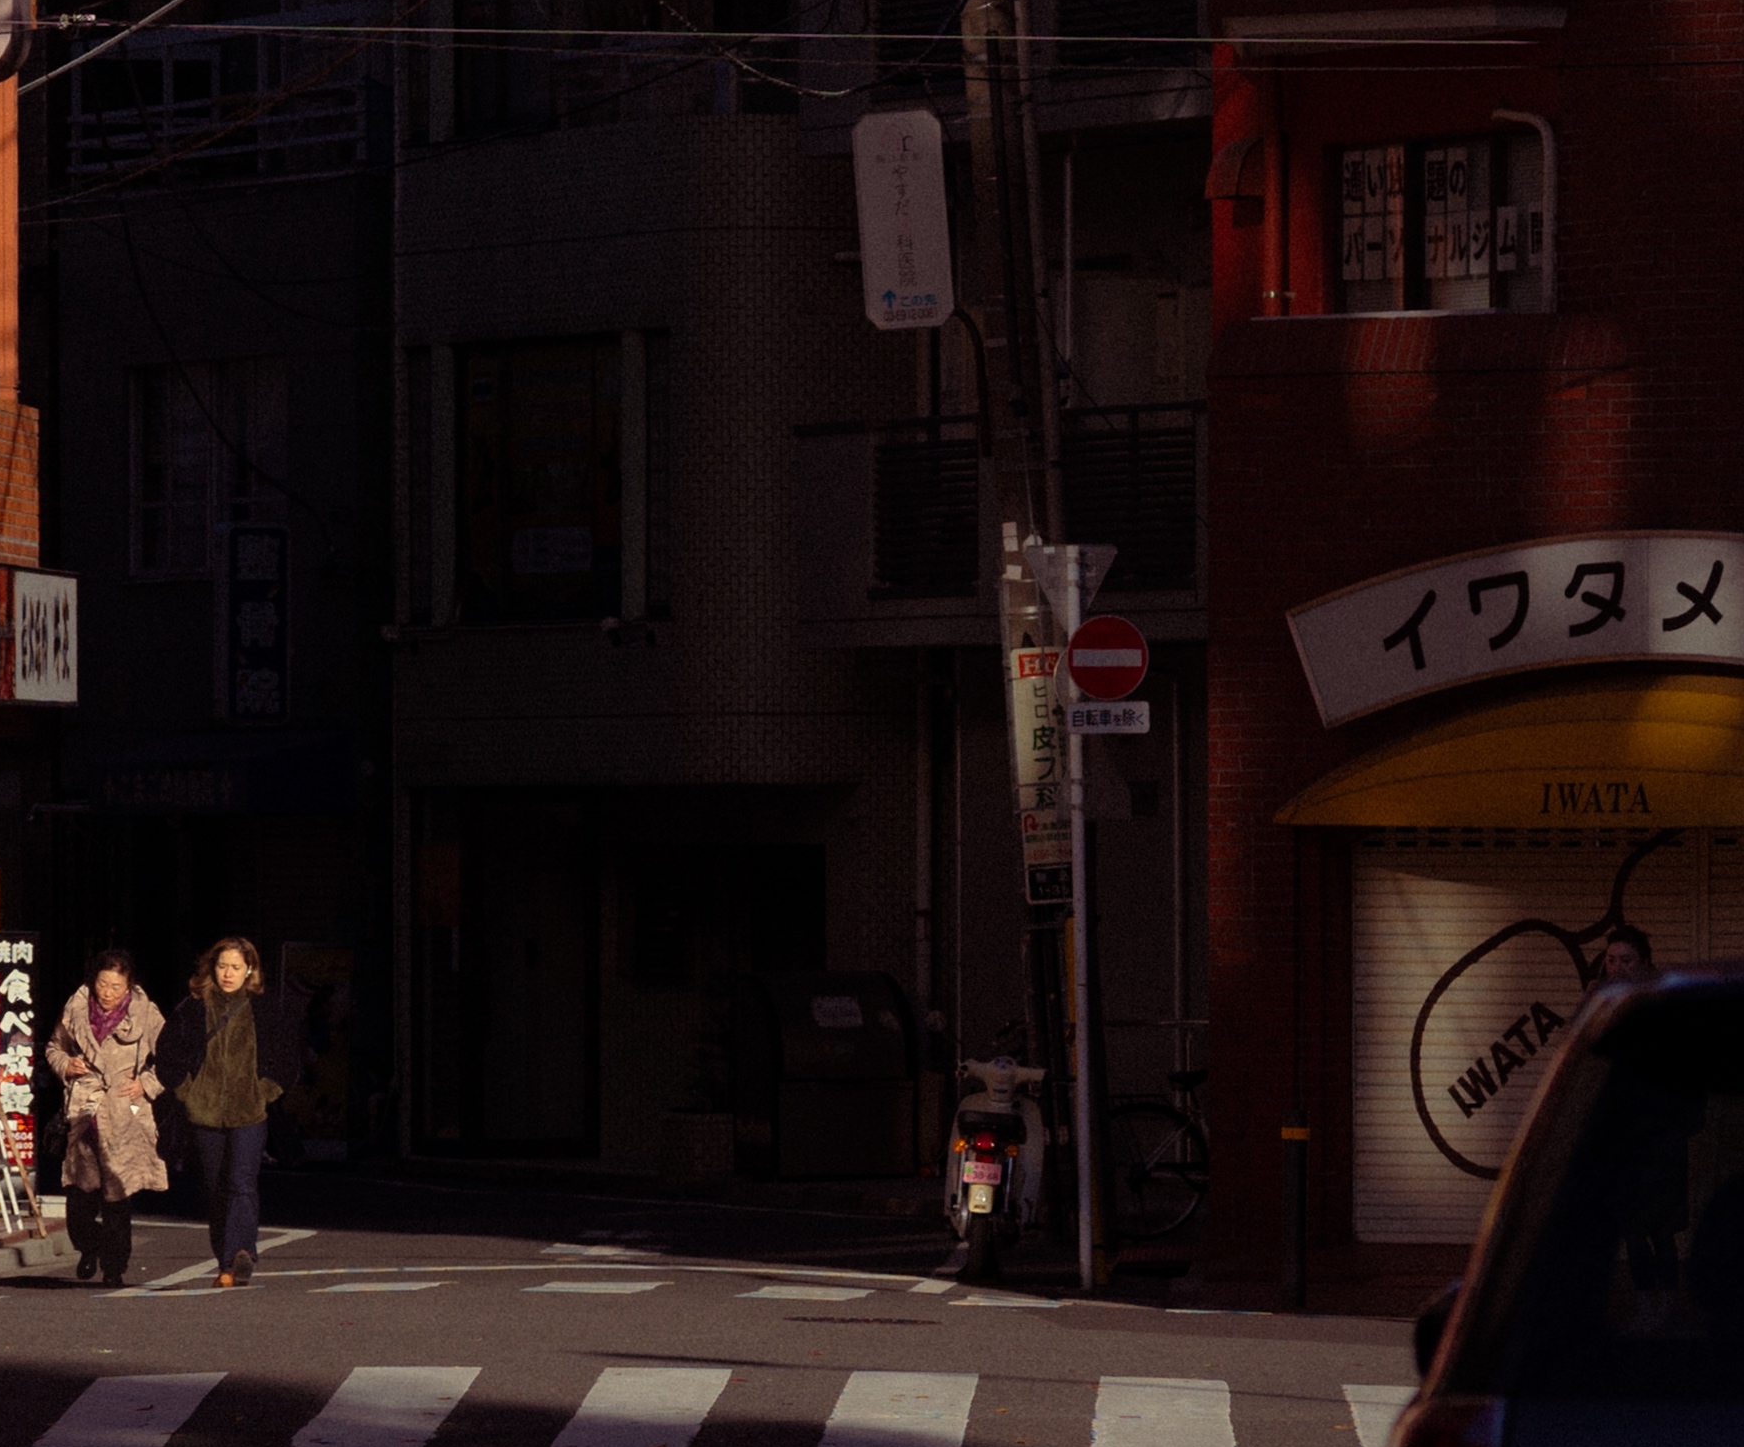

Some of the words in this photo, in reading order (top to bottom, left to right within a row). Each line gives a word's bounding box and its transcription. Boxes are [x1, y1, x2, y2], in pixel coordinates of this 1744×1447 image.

[1071, 708, 1146, 728] 自転車を除く
[1540, 781, 1653, 815] IWATA
[1447, 1000, 1566, 1119] IWATA
